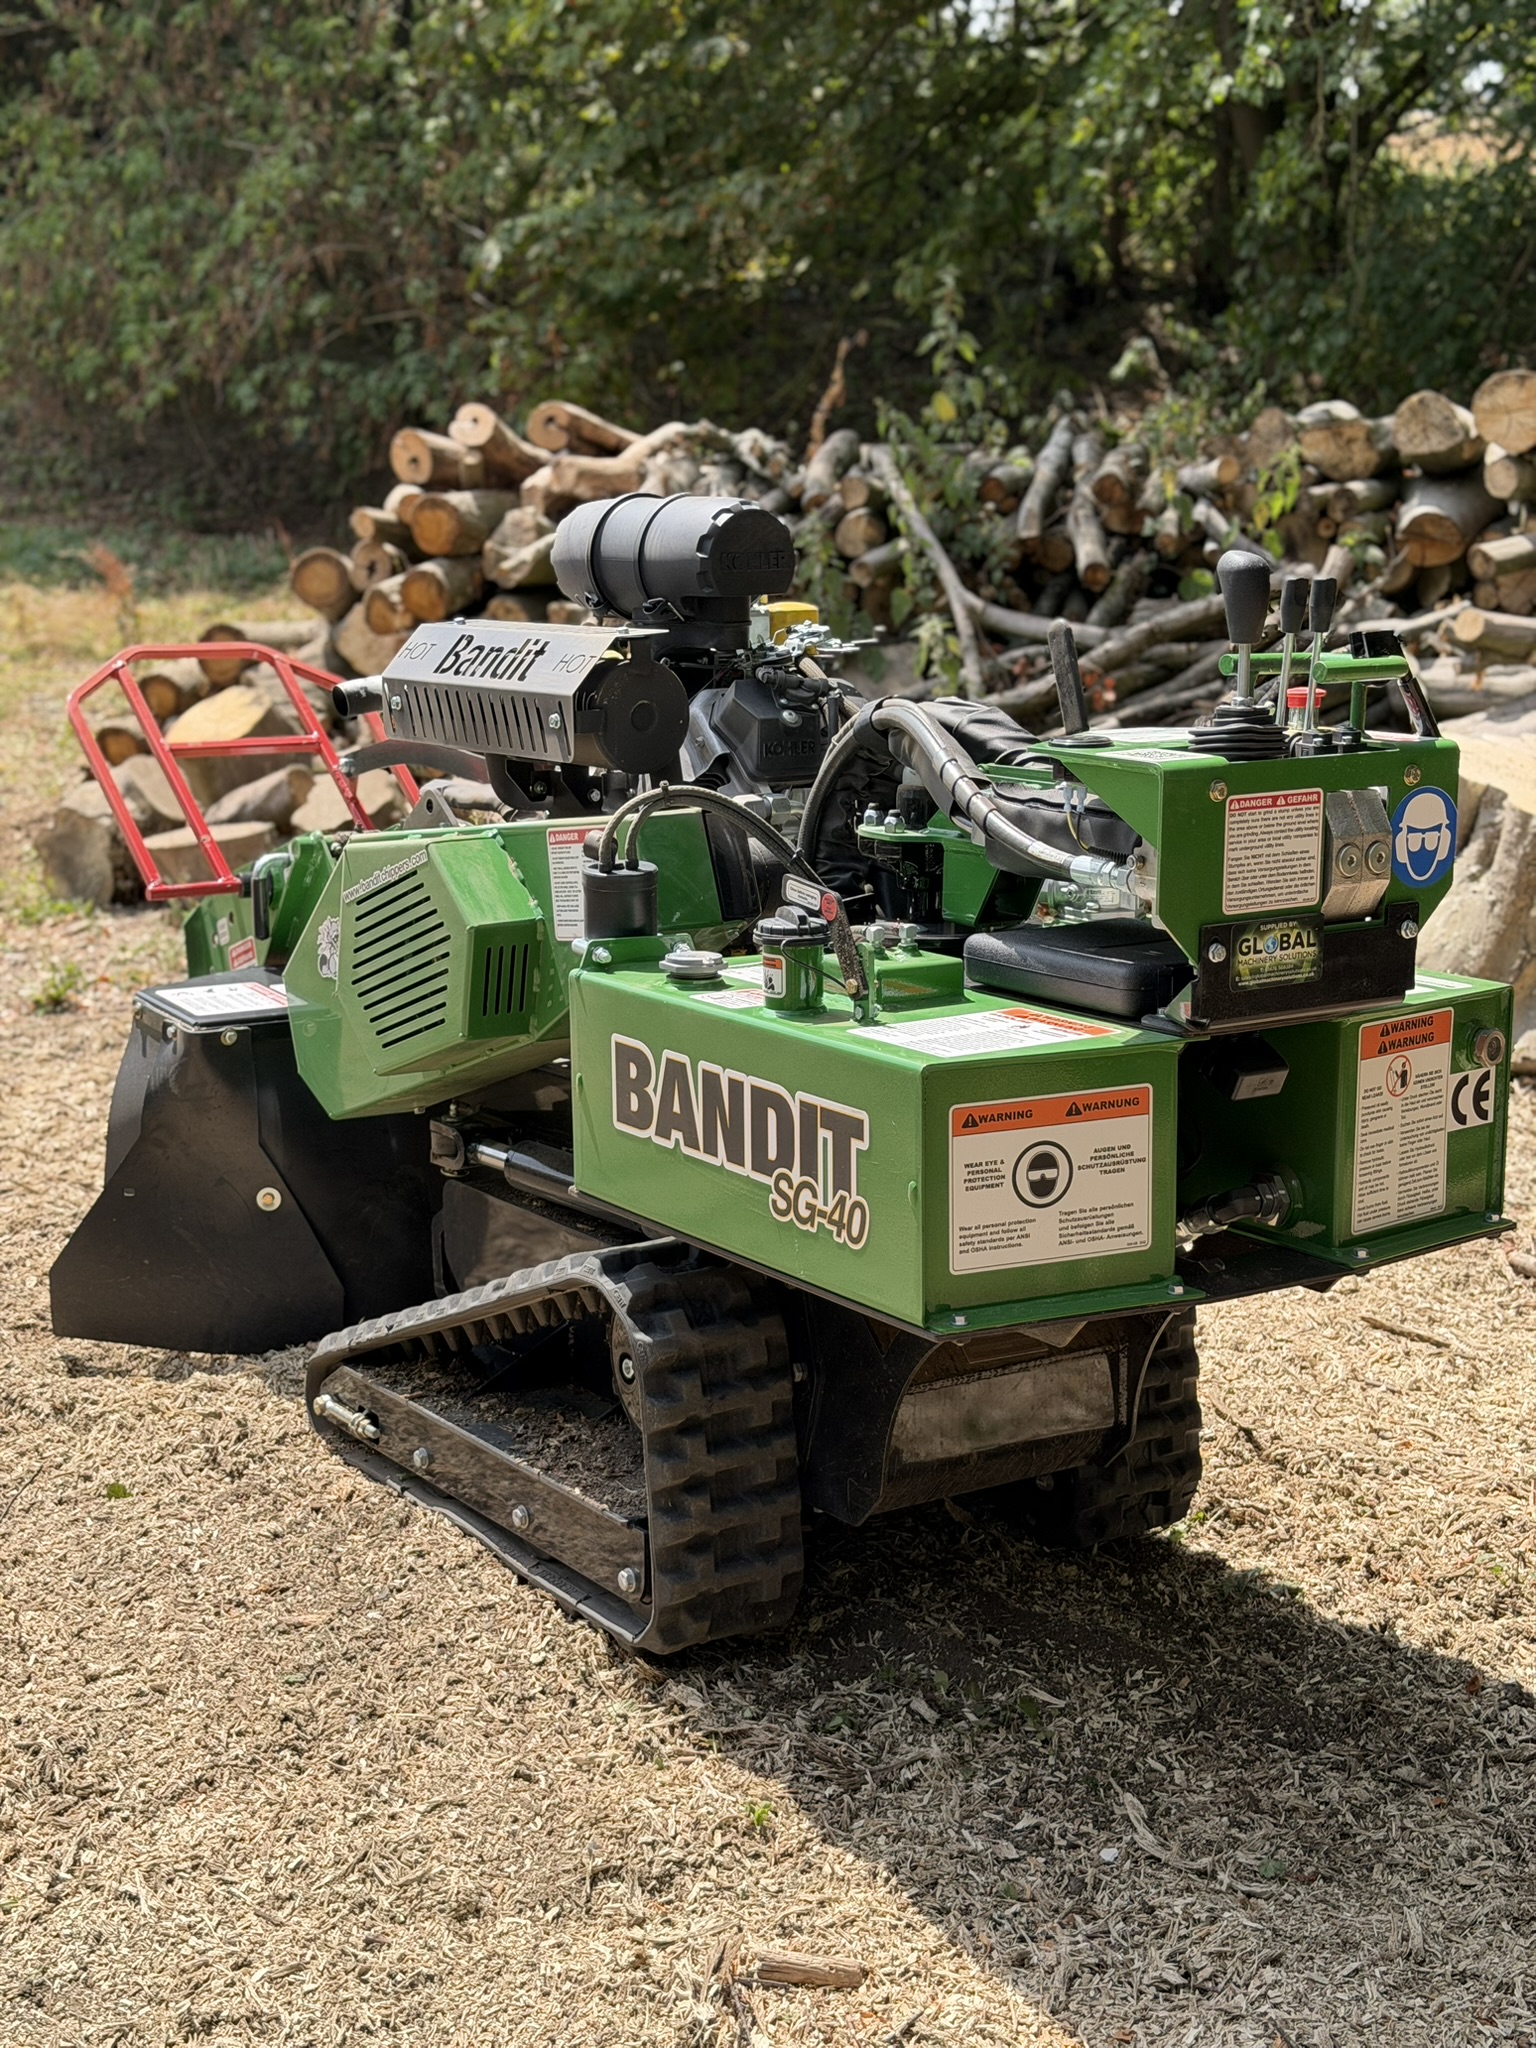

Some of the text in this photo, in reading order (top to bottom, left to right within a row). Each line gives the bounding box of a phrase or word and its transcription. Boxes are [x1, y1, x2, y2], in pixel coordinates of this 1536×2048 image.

[398, 642, 437, 660] HOT
[433, 634, 551, 682] Bandit
[551, 653, 598, 674] HOT
[762, 740, 817, 759] KOHLER
[1240, 798, 1272, 807] DANGER
[1287, 794, 1317, 803] GEFAHR
[556, 833, 579, 842] DANGER
[1260, 922, 1287, 930] SUPPLIED
[1237, 929, 1316, 957] GLOBAL
[1237, 949, 1316, 966] MACHINERY SOLUTIONS
[1390, 1015, 1433, 1034] WARNING
[1388, 1031, 1434, 1050] WARNUNG
[1082, 1097, 1139, 1111] WARNUNG
[612, 1035, 868, 1202] BANDIT
[978, 1109, 1032, 1124] WARNING
[1090, 1150, 1134, 1161] PERSÖNLICHE
[1077, 1155, 1145, 1170] SCHUTZAUSRÜSTUNG
[967, 1167, 1001, 1176] PERSONAL
[1099, 1167, 1124, 1175] TRAGEN
[963, 1174, 1005, 1184] PROTECTION
[965, 1181, 1003, 1192] EQUIPMENT
[771, 1171, 867, 1246] SG-40
[1058, 1208, 1077, 1217] Tragen
[982, 1221, 1006, 1229] personal
[1007, 1217, 1035, 1226] protection
[959, 1230, 987, 1240] equipment
[977, 1236, 1004, 1244] standards
[989, 1241, 1022, 1250] instructions.
